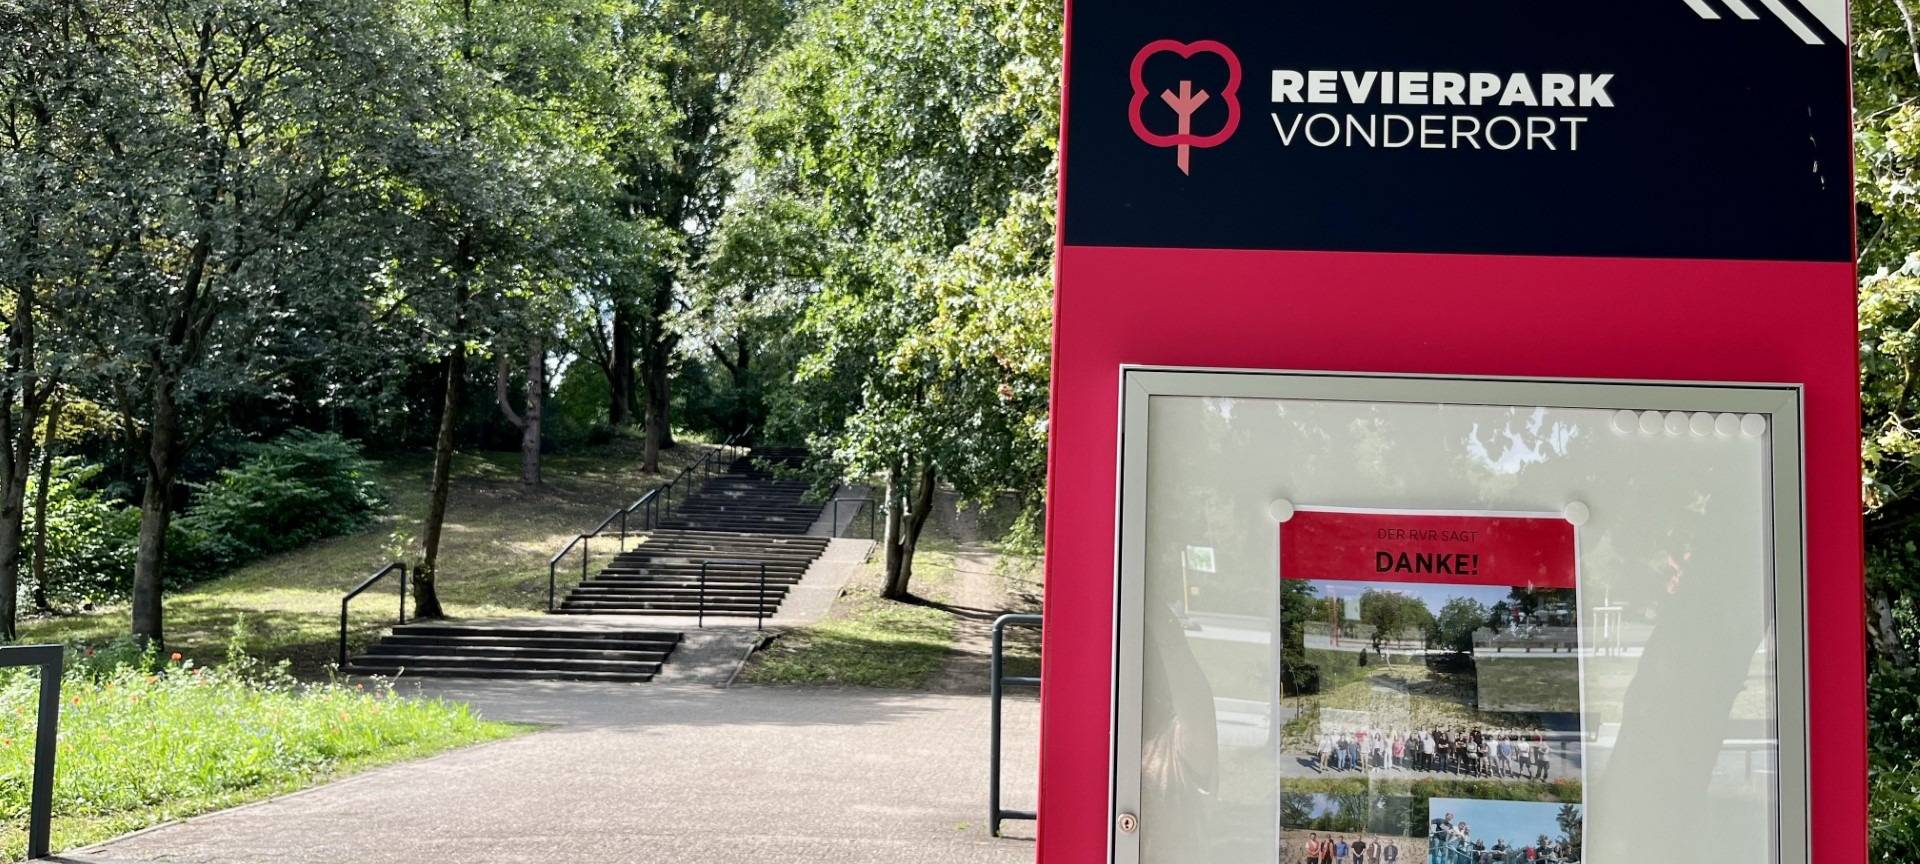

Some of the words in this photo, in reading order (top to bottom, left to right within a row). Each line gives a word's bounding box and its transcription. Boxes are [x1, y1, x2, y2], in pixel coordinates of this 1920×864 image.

[1271, 70, 1614, 107] REVIERPARK
[1271, 113, 1587, 150] VONDERORT
[1377, 528, 1405, 541] DER
[1409, 528, 1437, 541] RVR
[1441, 530, 1478, 542] SAGT
[1376, 551, 1478, 575] DANKE!
